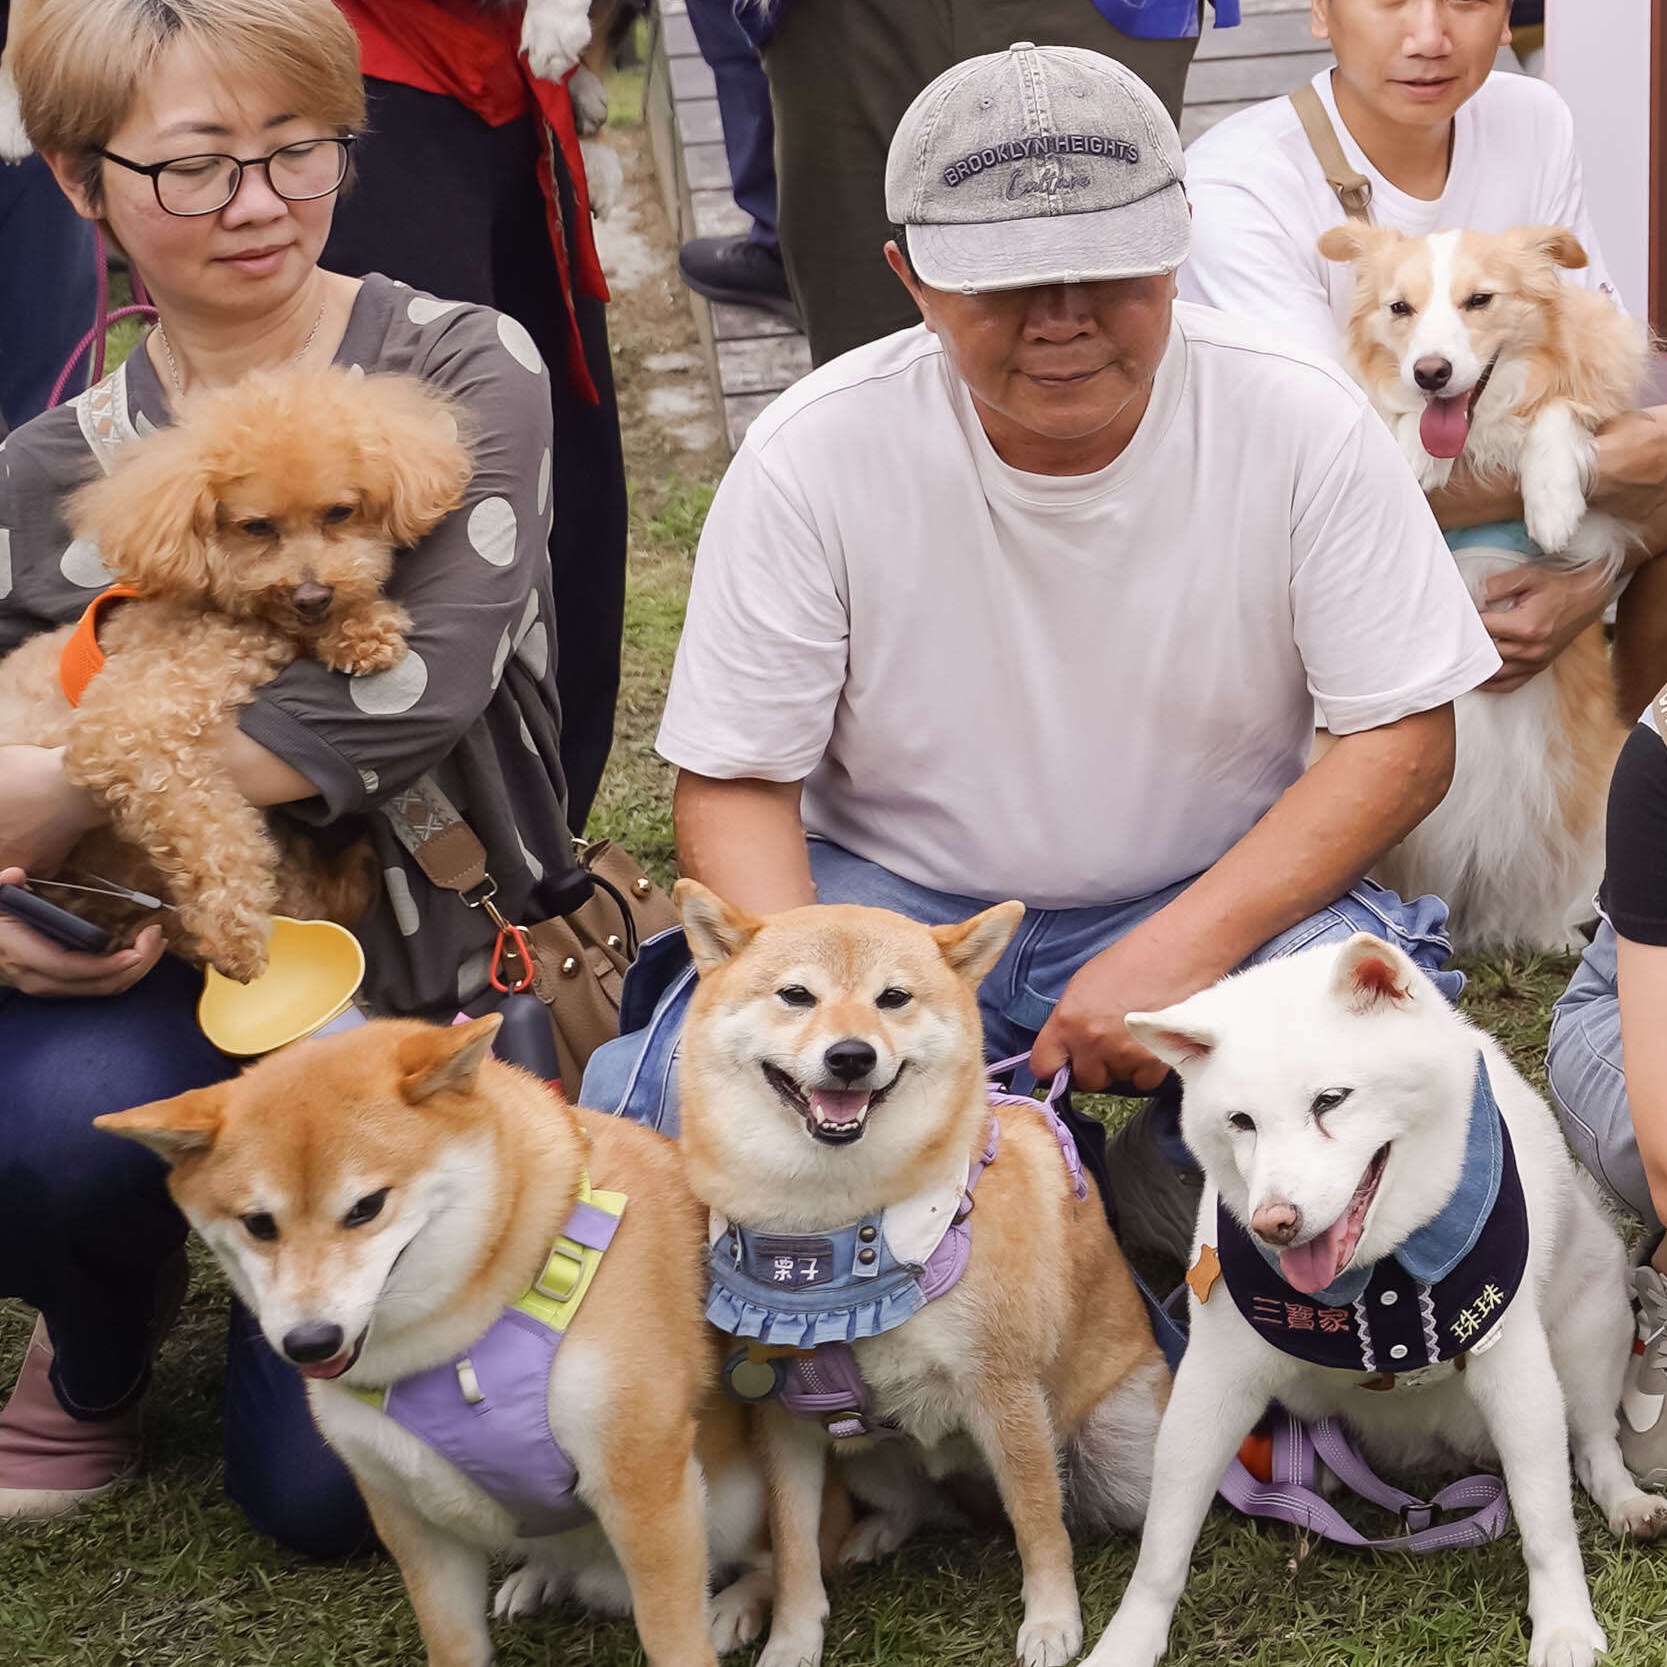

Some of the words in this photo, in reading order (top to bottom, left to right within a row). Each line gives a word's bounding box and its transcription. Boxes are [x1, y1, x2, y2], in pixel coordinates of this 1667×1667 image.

[943, 135, 1050, 188] BROOKLYN
[1054, 133, 1140, 164] HEIGHTS
[1449, 1282, 1506, 1344] 珠珠
